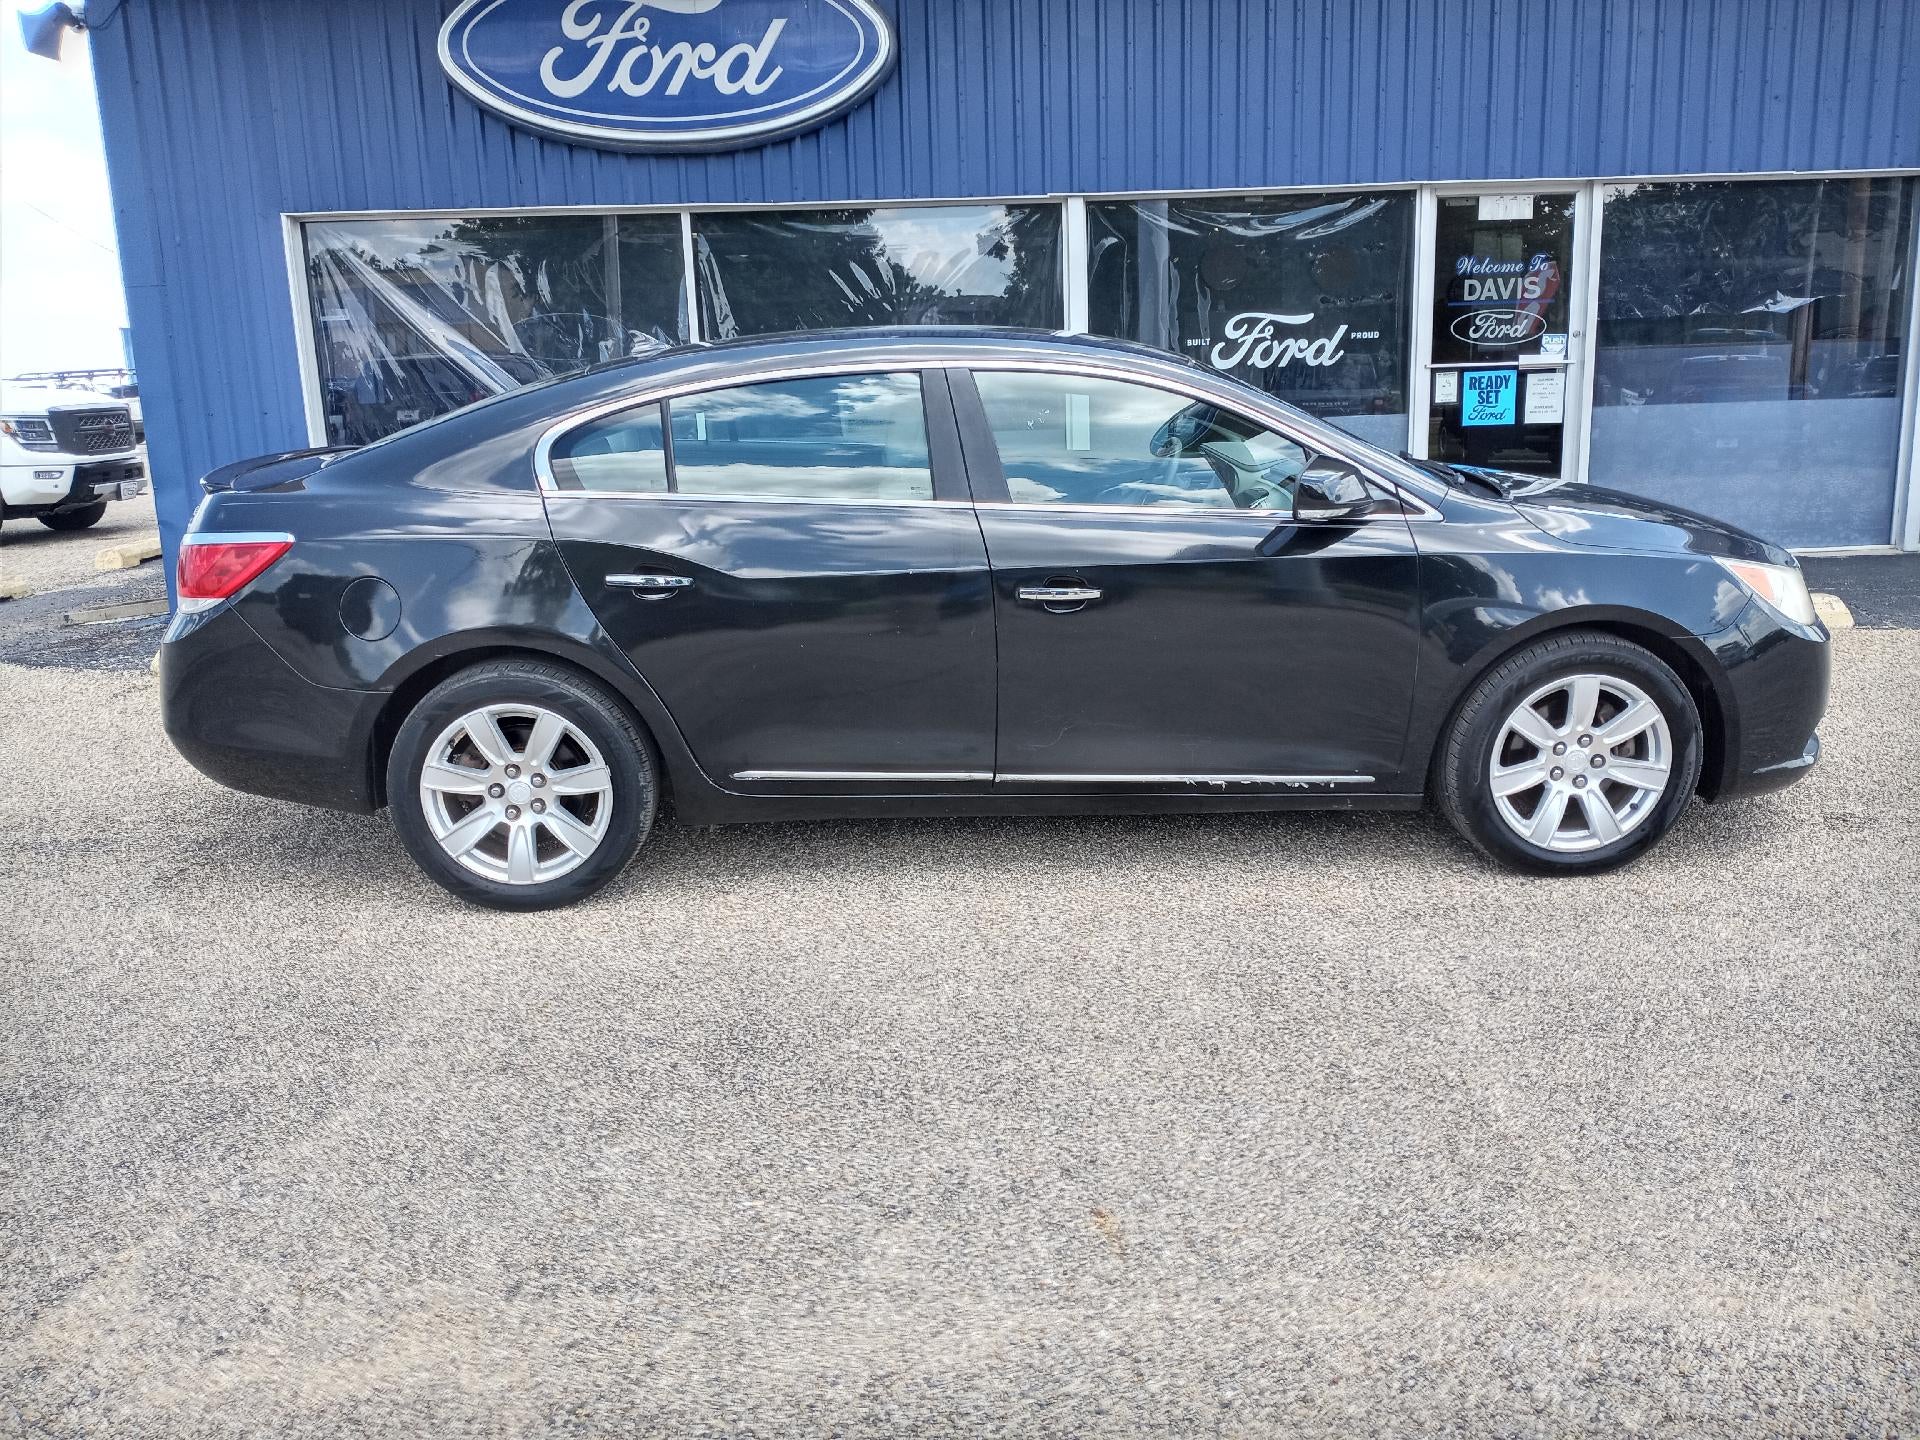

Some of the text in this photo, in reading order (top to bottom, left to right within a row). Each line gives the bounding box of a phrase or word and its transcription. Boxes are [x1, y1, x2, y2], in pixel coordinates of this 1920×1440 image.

[540, 0, 788, 98] Ford
[1457, 254, 1549, 275] Welcome To
[1464, 276, 1541, 301] DAVIS
[1469, 313, 1529, 339] Ford
[1187, 312, 1380, 370] BUILT Ford PROUD
[1544, 335, 1565, 344] Push
[1469, 374, 1511, 391] READY
[1477, 389, 1501, 405] SET
[1468, 404, 1507, 421] Ford
